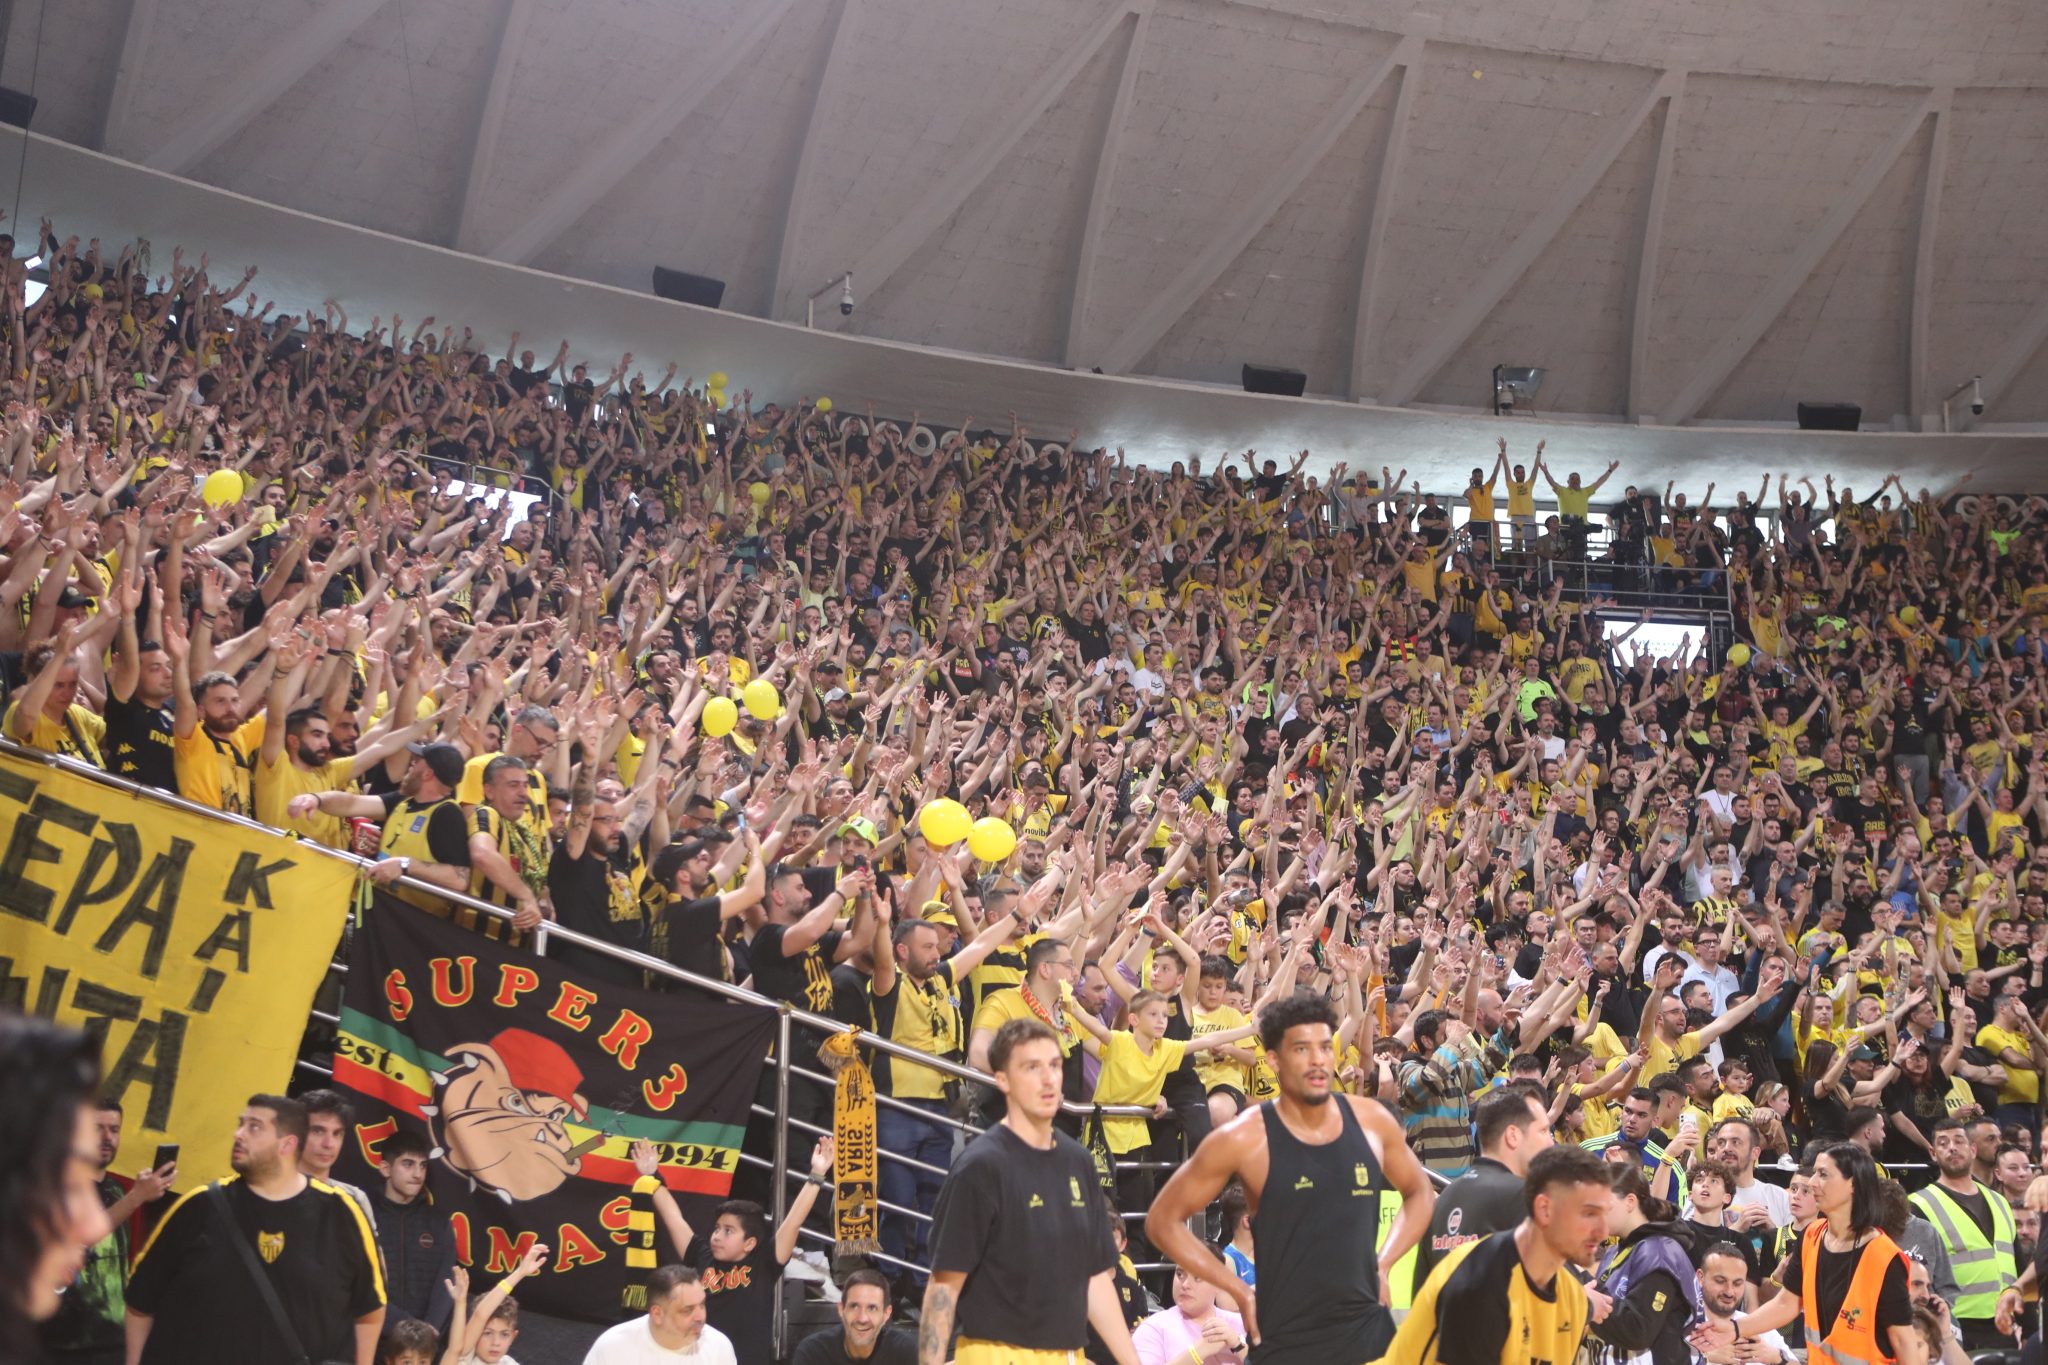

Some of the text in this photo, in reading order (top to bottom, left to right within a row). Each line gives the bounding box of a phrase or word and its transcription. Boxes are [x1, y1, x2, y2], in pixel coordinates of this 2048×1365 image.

[333, 1036, 405, 1081] est.
[385, 956, 688, 1112] SUPER 3
